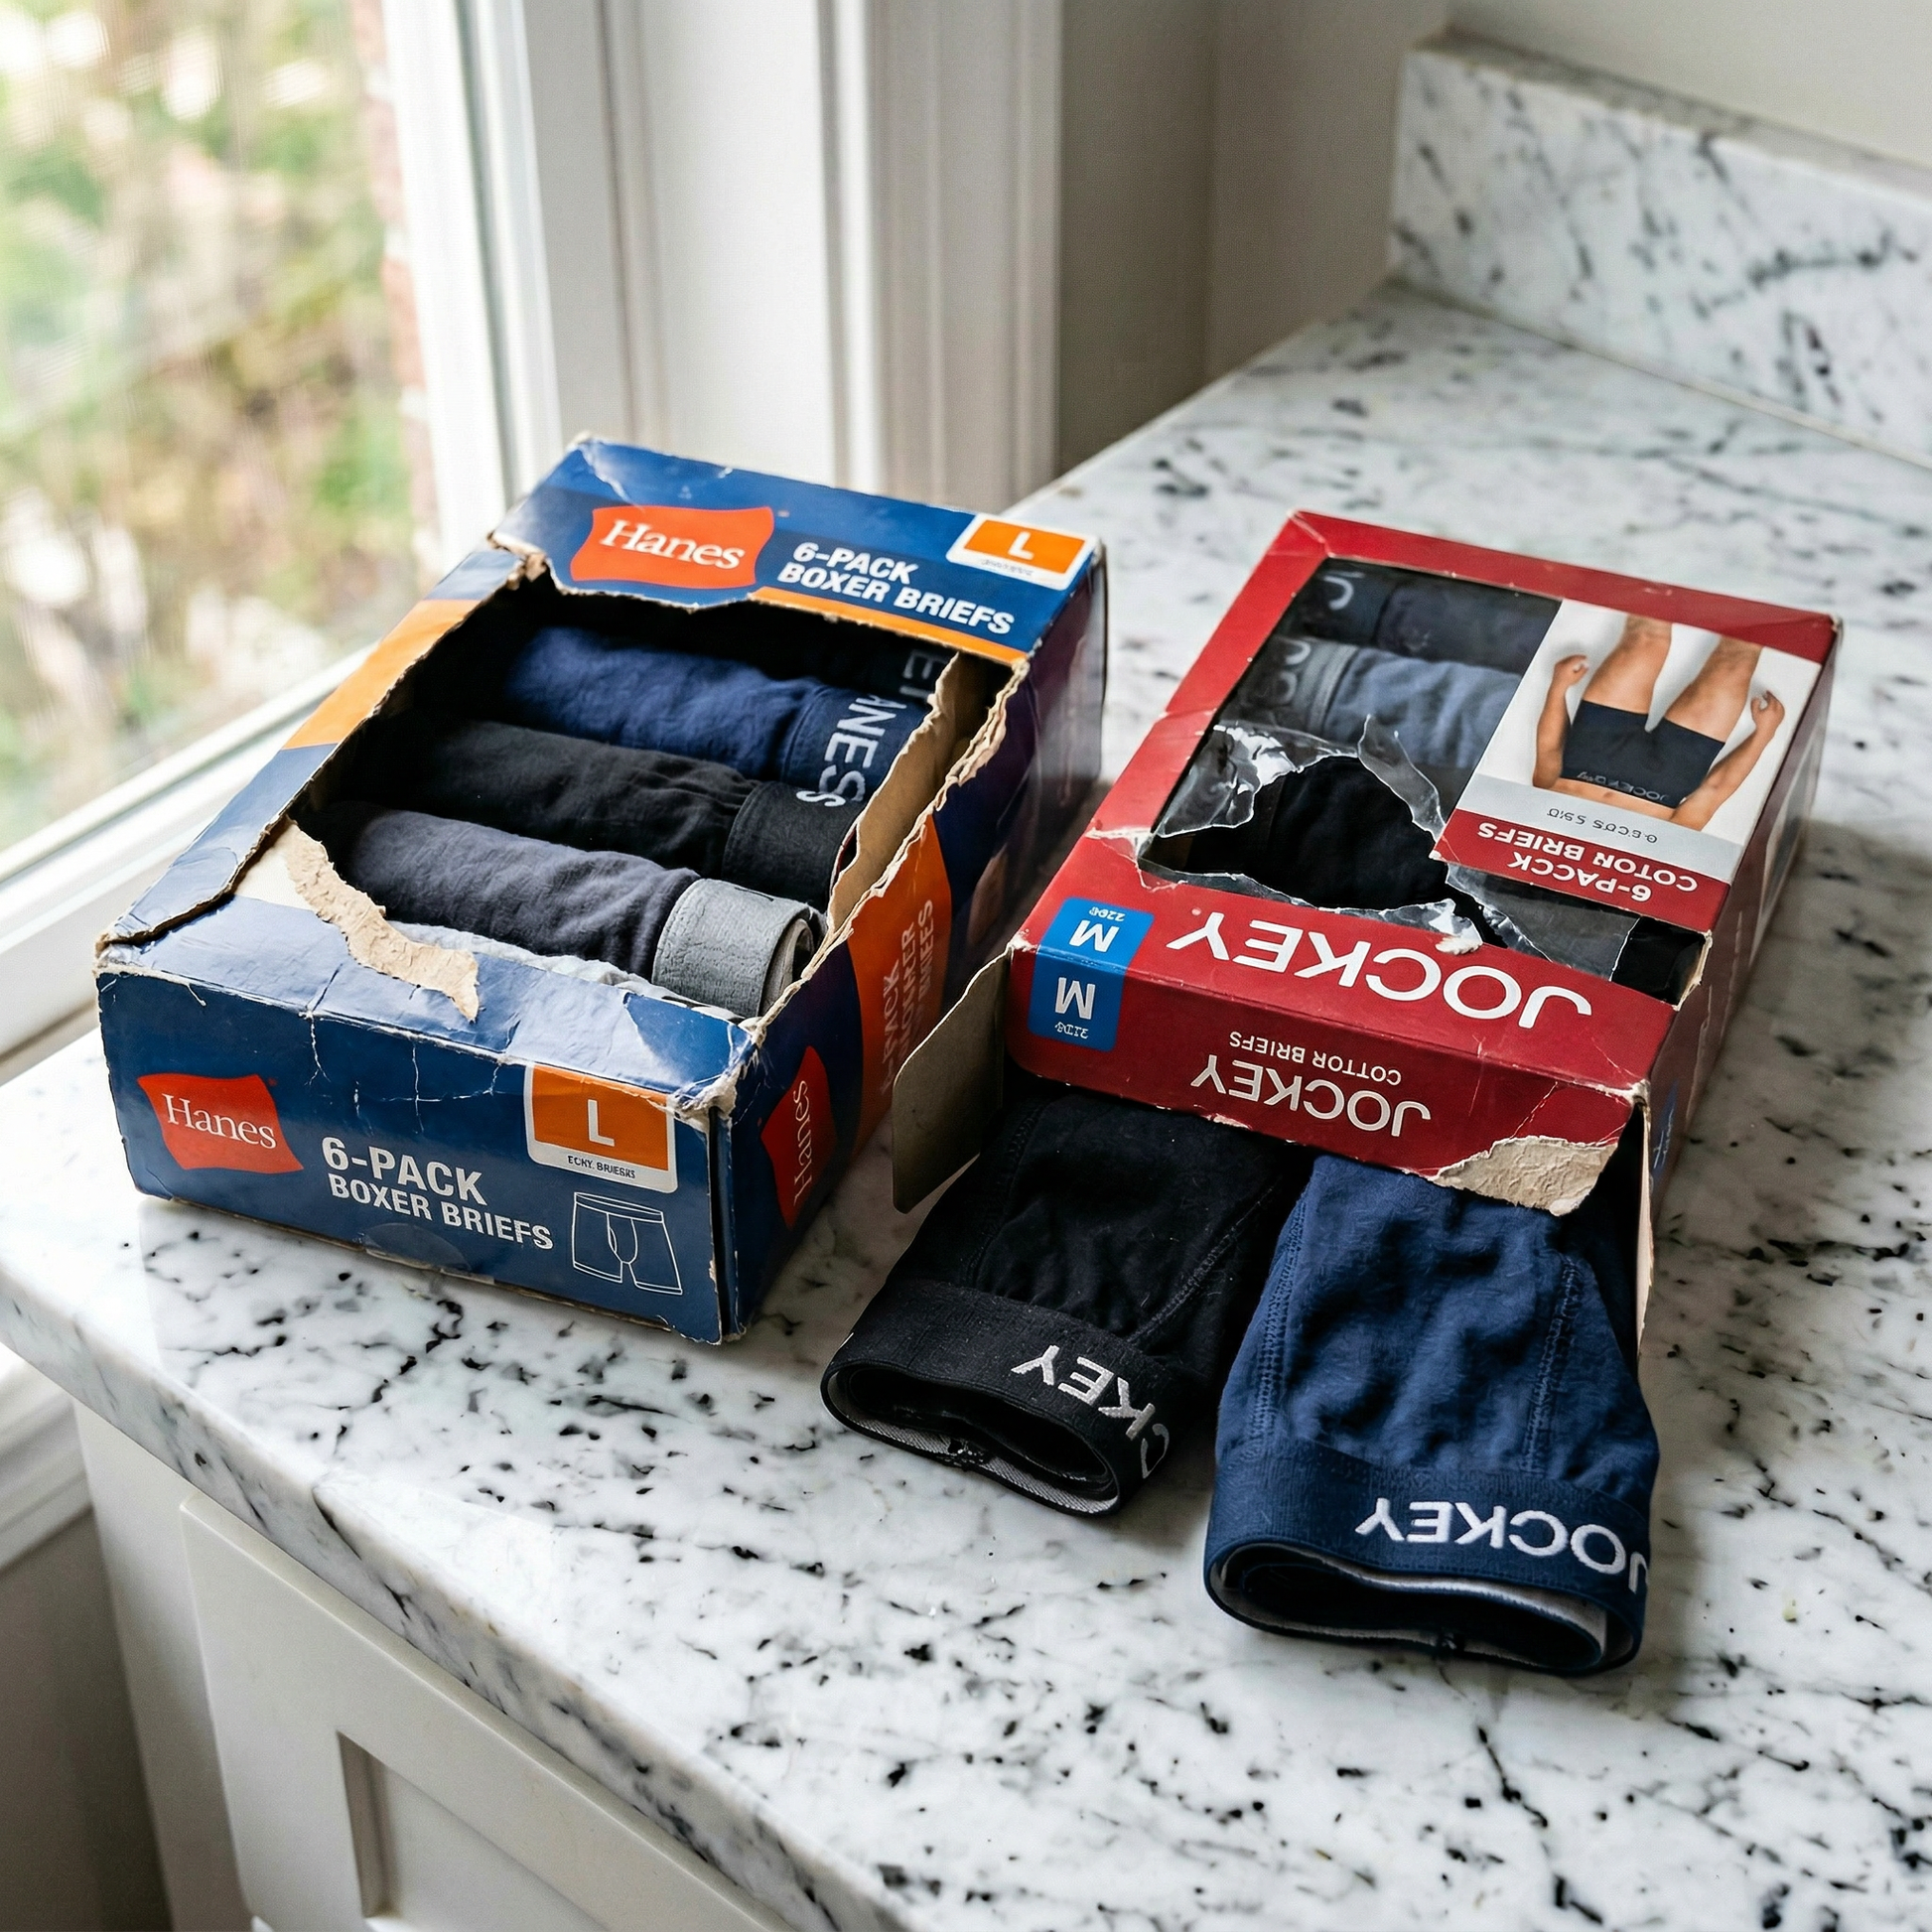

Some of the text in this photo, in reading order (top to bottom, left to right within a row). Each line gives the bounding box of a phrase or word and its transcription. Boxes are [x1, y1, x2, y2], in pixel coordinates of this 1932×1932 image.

[600, 519, 745, 571] Hanes
[792, 541, 919, 585] 6-PACK
[1007, 531, 1035, 560] L
[777, 561, 1016, 635] BOXER BRIEFS
[1477, 822, 1587, 861] BRIEFS
[1507, 852, 1653, 901] 6-PACCK
[1069, 920, 1117, 953] M
[1166, 910, 1592, 1029] JOCKEY
[1054, 977, 1096, 1021] M
[1228, 1030, 1402, 1086] COTTOR BRIEFS
[162, 1094, 277, 1150] Hanes
[1190, 1054, 1432, 1138] JOCKEY
[587, 1100, 615, 1148] L
[792, 1080, 813, 1205] Hanes
[323, 1138, 488, 1205] 6-PACK
[327, 1173, 554, 1249] BOXER BRIEFS
